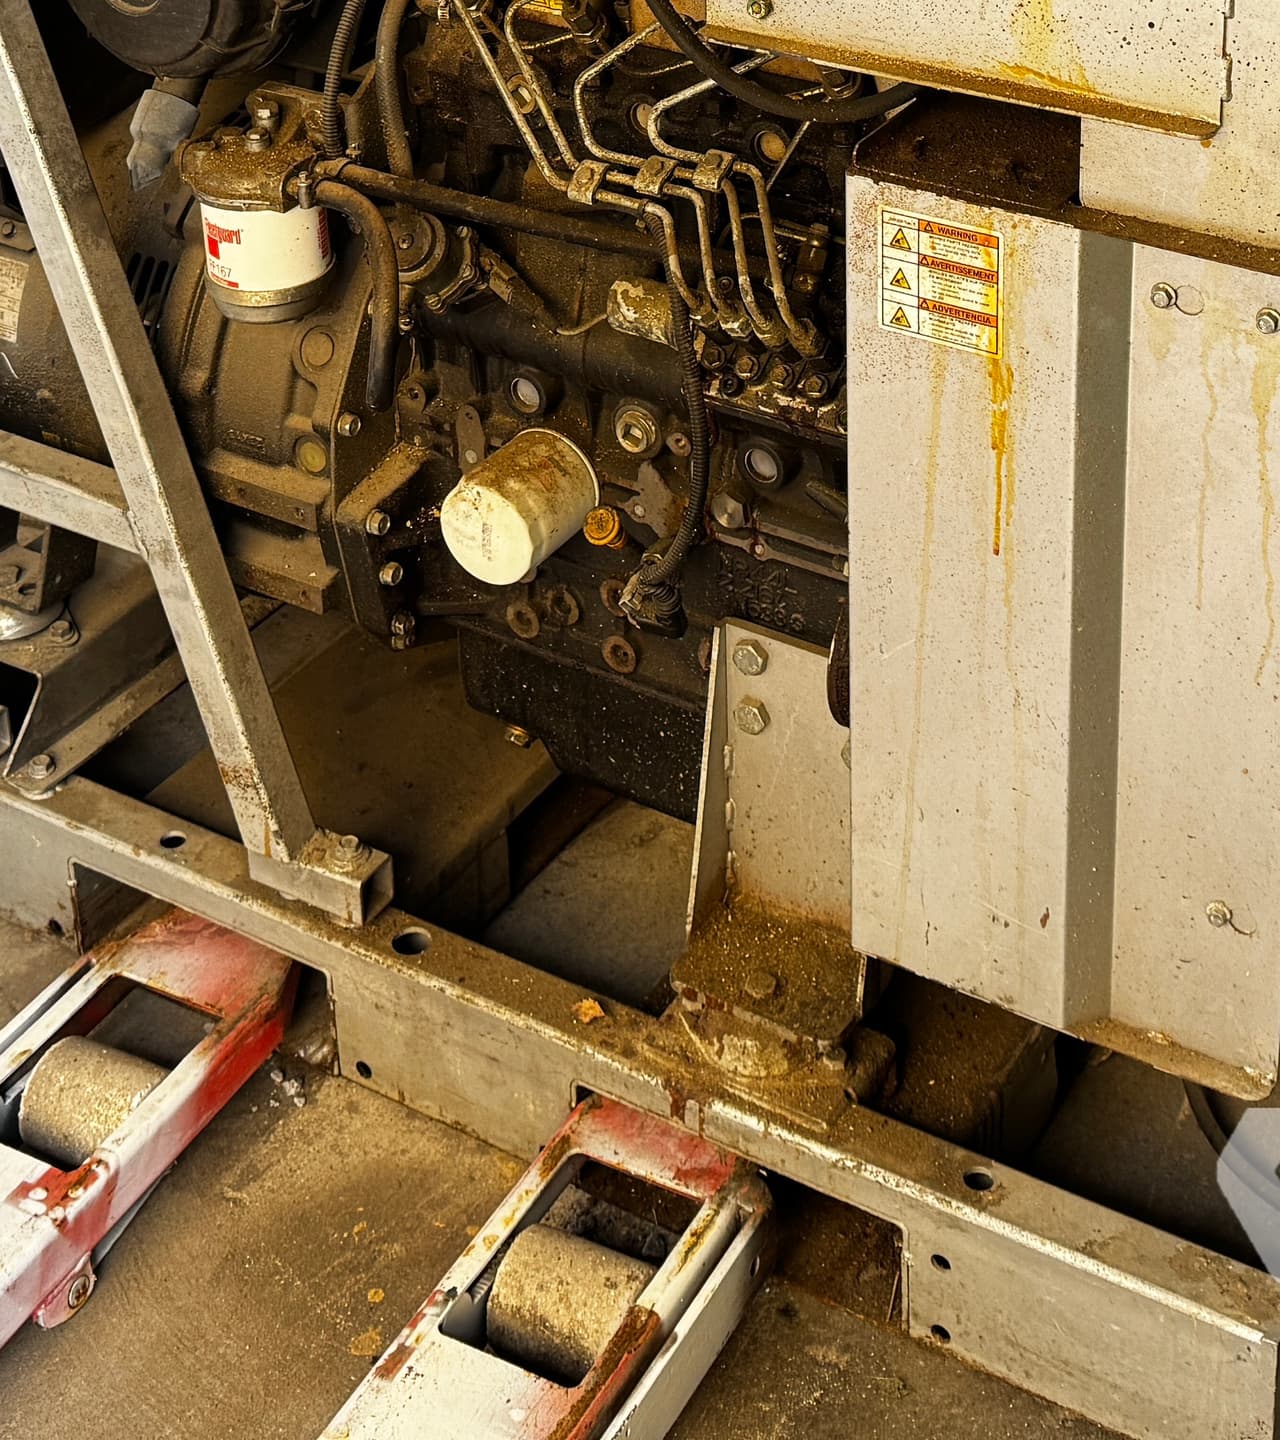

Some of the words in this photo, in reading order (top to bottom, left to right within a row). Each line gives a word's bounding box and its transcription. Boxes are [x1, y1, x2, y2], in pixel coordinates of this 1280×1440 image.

[937, 226, 978, 242] WARNING
[930, 259, 995, 281] AVERTISSEMENT
[931, 303, 992, 325] ADVERTENCIA
